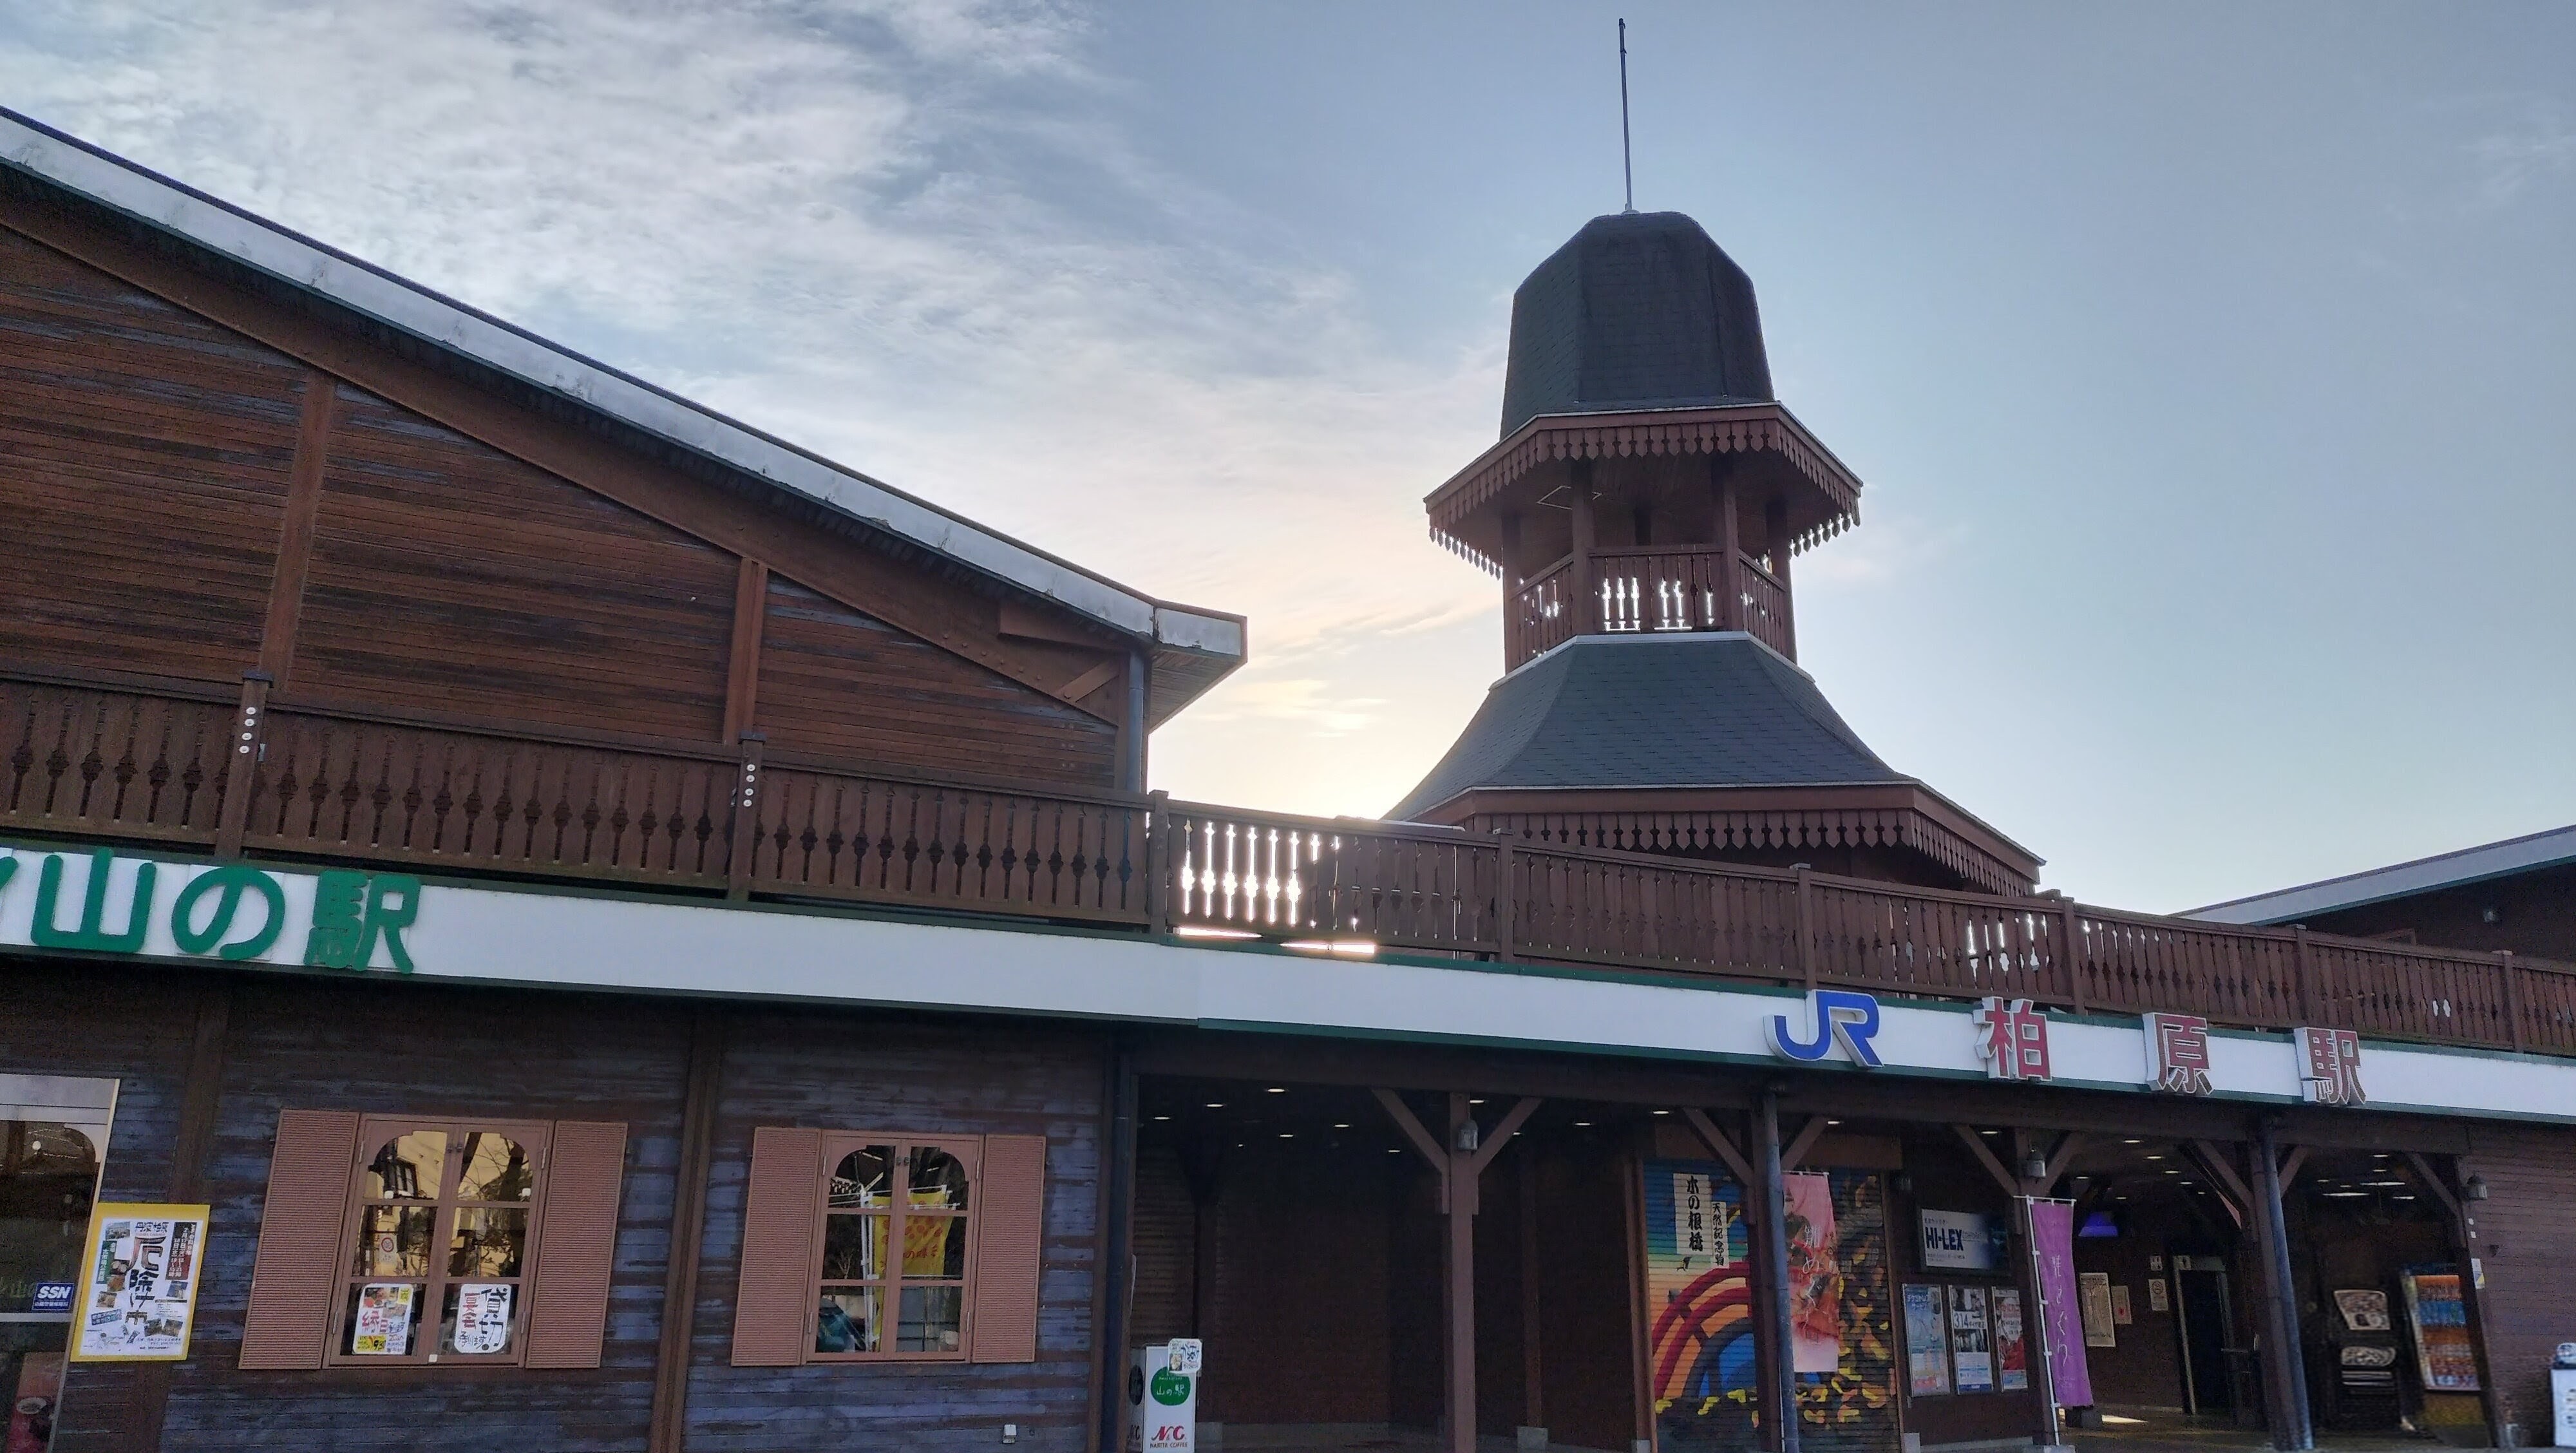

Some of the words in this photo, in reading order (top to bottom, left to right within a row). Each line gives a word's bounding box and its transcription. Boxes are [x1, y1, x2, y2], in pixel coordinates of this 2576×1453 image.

[0, 846, 422, 974] 山の駅
[1764, 989, 1885, 1068] JR
[1976, 996, 2366, 1105] 柏原駅
[1686, 1175, 1704, 1252] 木の根橋
[1712, 1202, 1725, 1267] 天然記念物
[1925, 1226, 1964, 1251] HI-LEX
[37, 1286, 71, 1299] SSN
[1156, 1383, 1185, 1396] 山の駅
